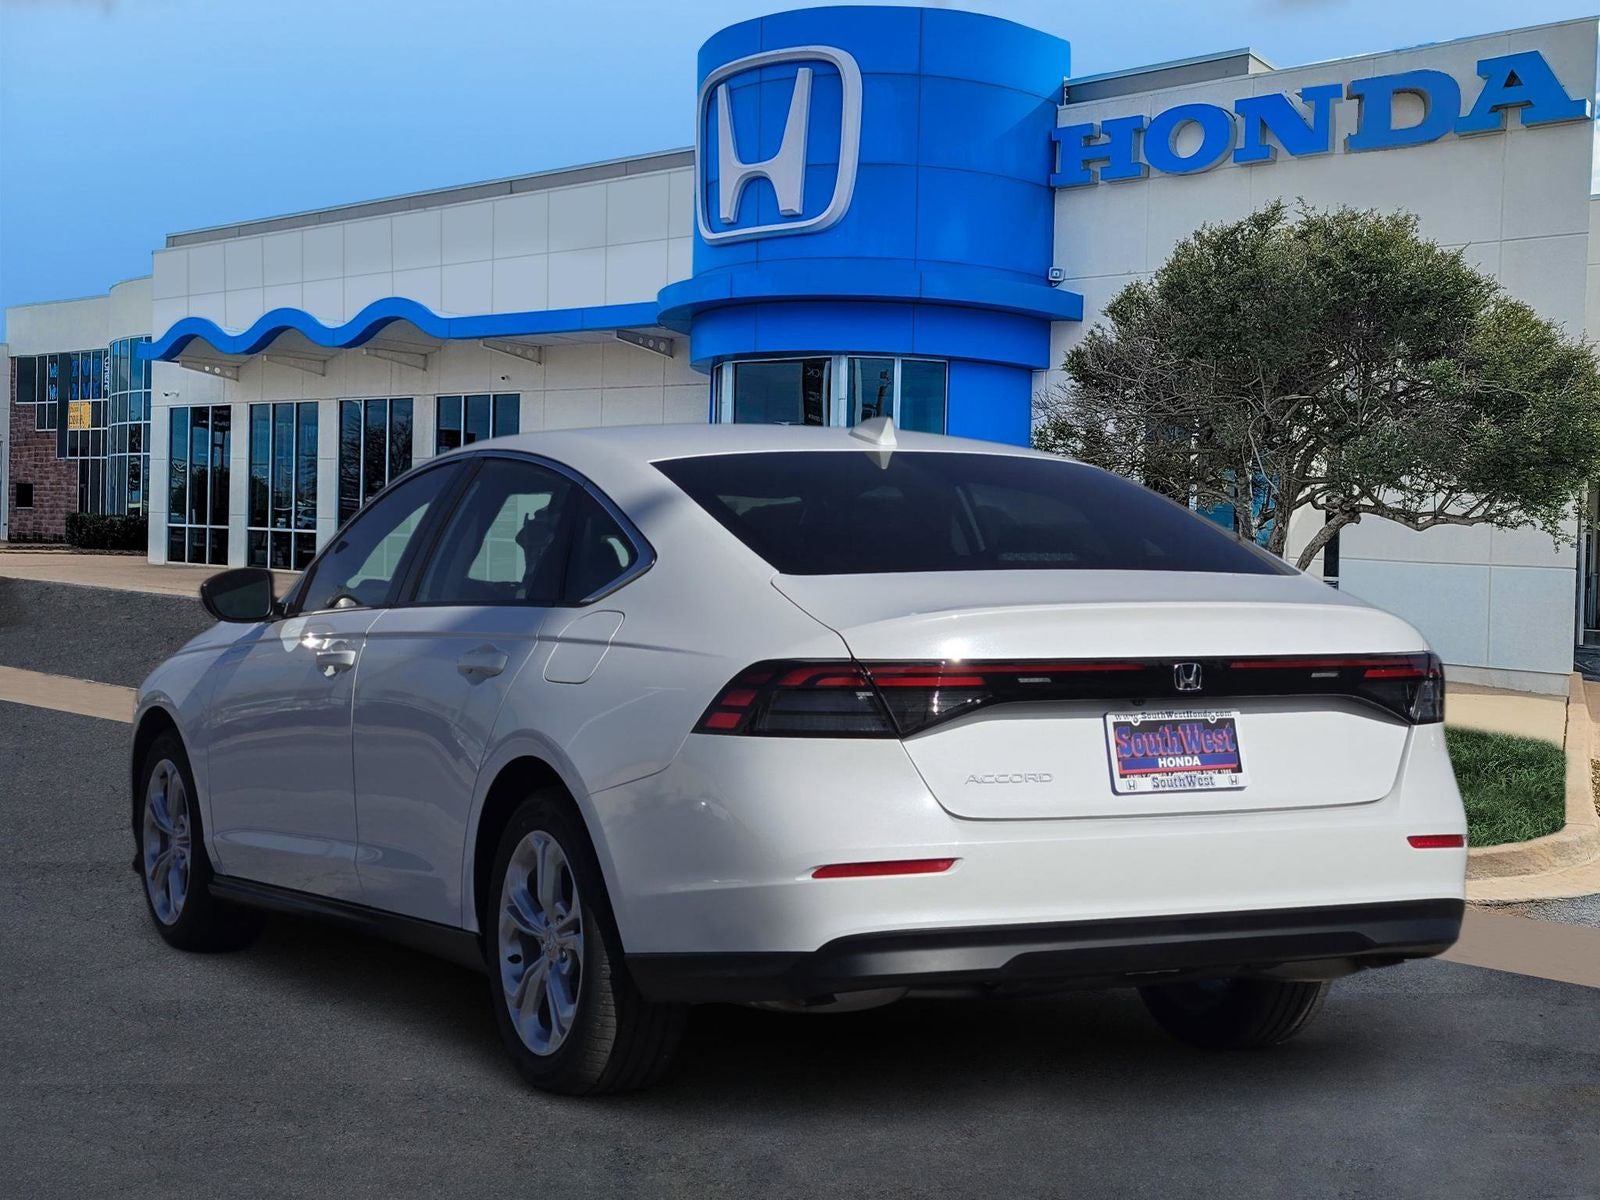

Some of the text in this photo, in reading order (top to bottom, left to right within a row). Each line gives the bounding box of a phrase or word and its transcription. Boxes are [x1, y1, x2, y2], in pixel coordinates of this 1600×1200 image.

[1051, 50, 1591, 188] HONDA
[1114, 709, 1233, 721] www.SouthWestHondacom
[1115, 722, 1237, 757] SouthWest
[1157, 755, 1202, 768] HONDA
[964, 773, 1053, 784] ACCORD
[1151, 776, 1215, 788] SouthWest
